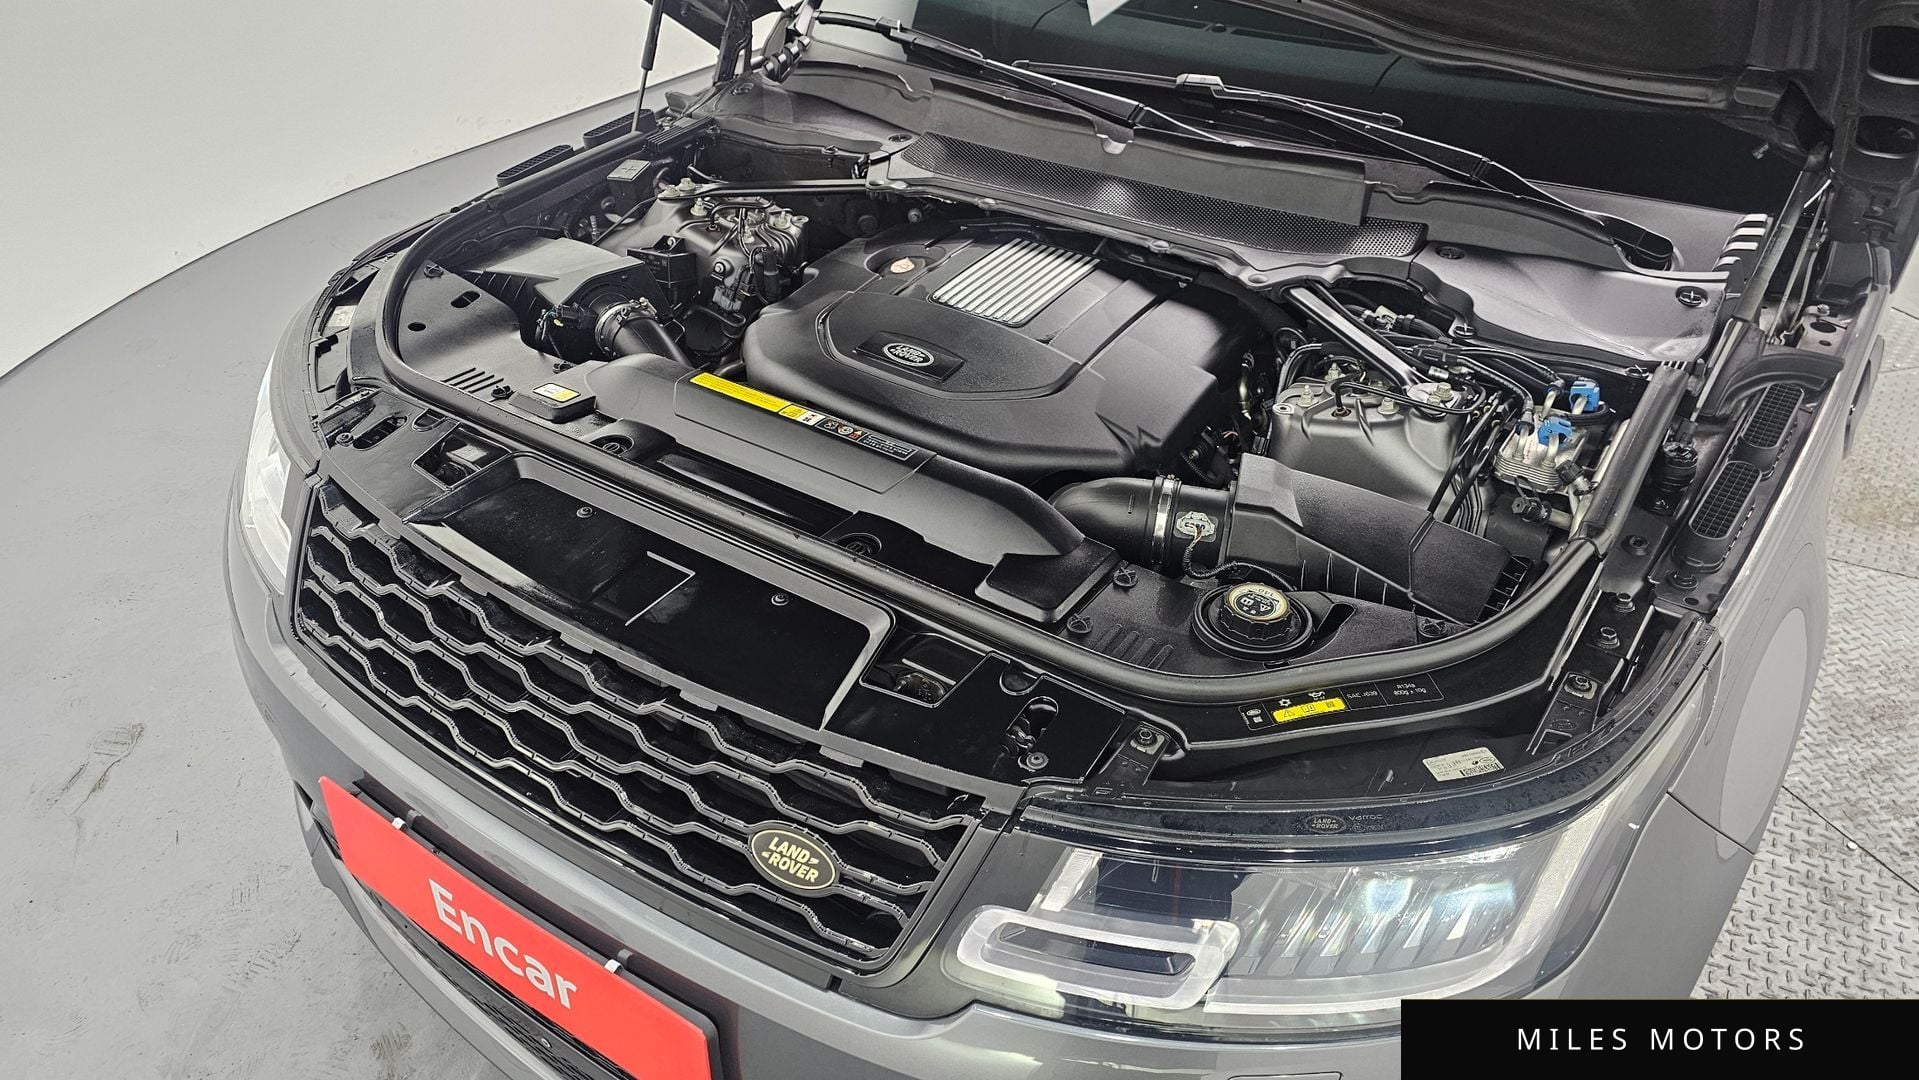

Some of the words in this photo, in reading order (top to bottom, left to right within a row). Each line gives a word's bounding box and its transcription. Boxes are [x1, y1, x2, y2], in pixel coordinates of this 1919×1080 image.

[893, 350, 923, 363] ROVER
[895, 345, 921, 356] LAND
[768, 836, 811, 864] LAND
[768, 851, 819, 883] ROVER
[428, 878, 577, 1010] Encar
